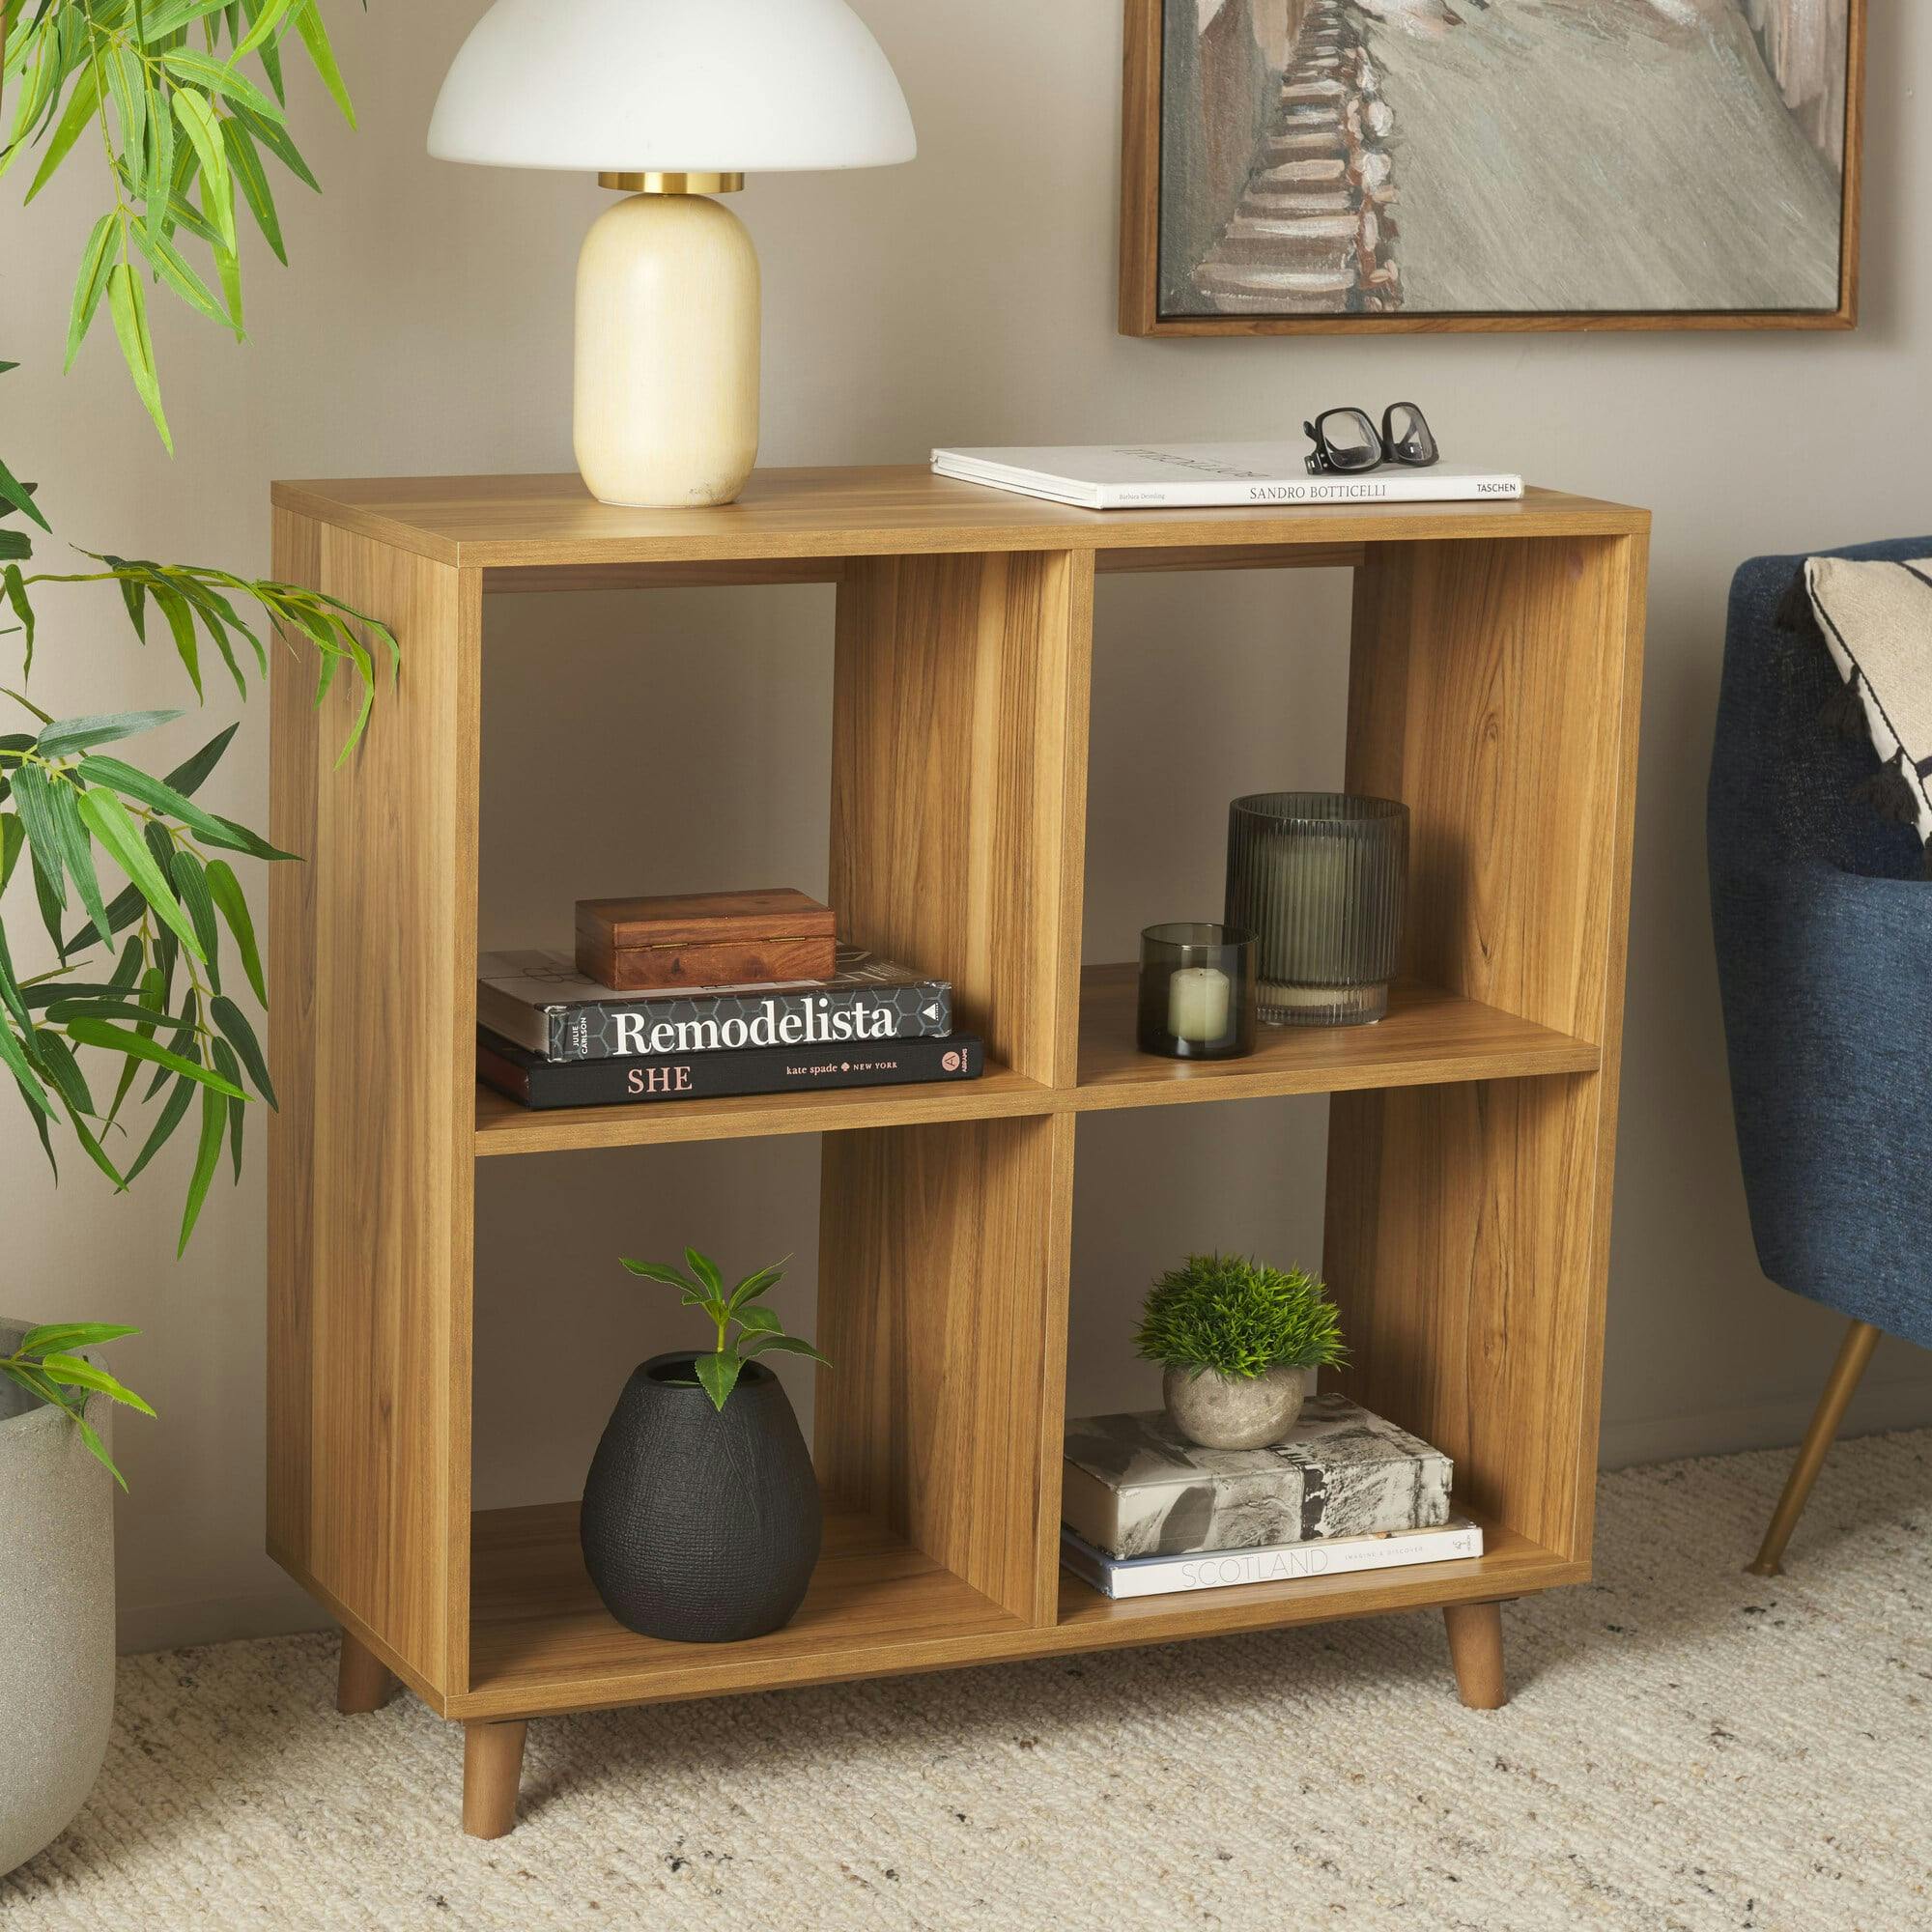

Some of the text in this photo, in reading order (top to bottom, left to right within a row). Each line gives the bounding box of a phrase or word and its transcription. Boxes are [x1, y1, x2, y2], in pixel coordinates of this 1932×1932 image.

[1249, 484, 1386, 499] SANDRO BOTTICELLI
[1476, 483, 1517, 493] TASCHEN
[611, 997, 897, 1056] Remodelista
[628, 1065, 693, 1094] SHE
[786, 1065, 808, 1075] kate
[810, 1064, 838, 1076] spade
[1181, 1548, 1328, 1588] SCOTLAND
